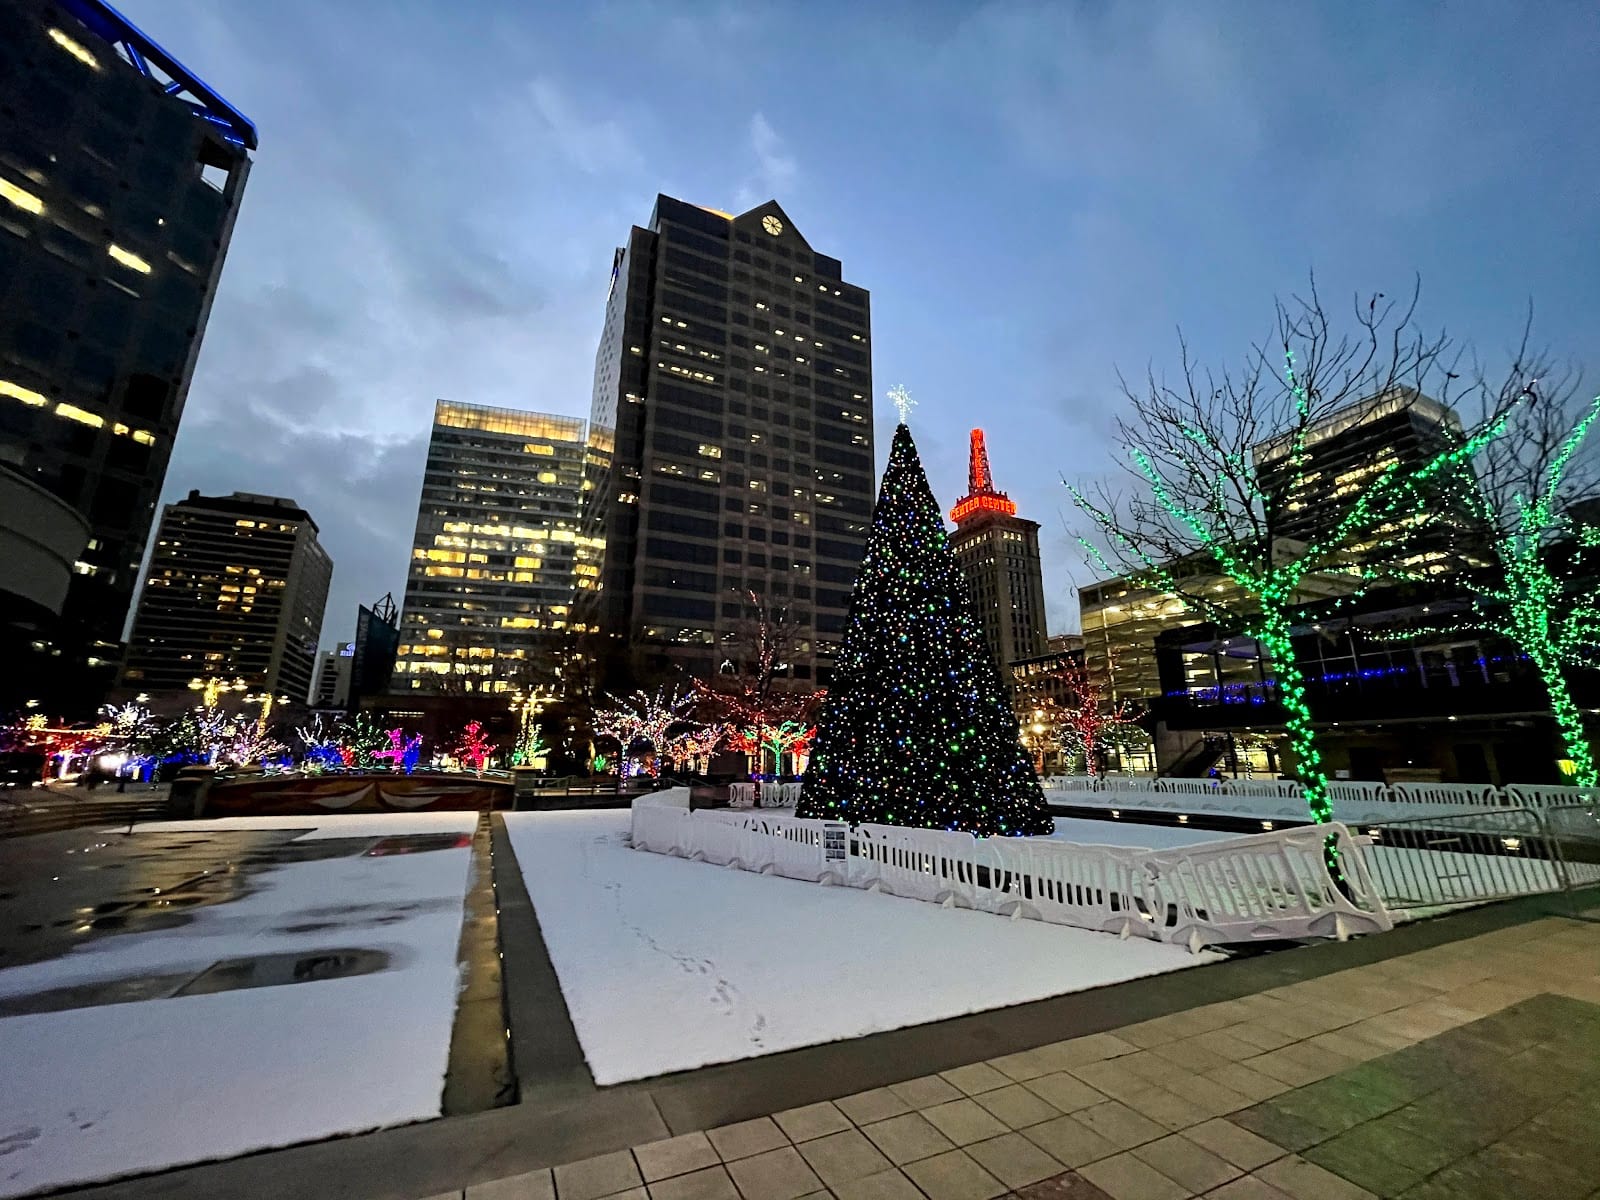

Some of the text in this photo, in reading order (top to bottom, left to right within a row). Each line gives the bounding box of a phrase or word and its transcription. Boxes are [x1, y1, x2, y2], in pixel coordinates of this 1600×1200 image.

[972, 428, 985, 488] WALKER
[950, 496, 980, 521] CENTER
[981, 496, 1017, 515] CENTER
